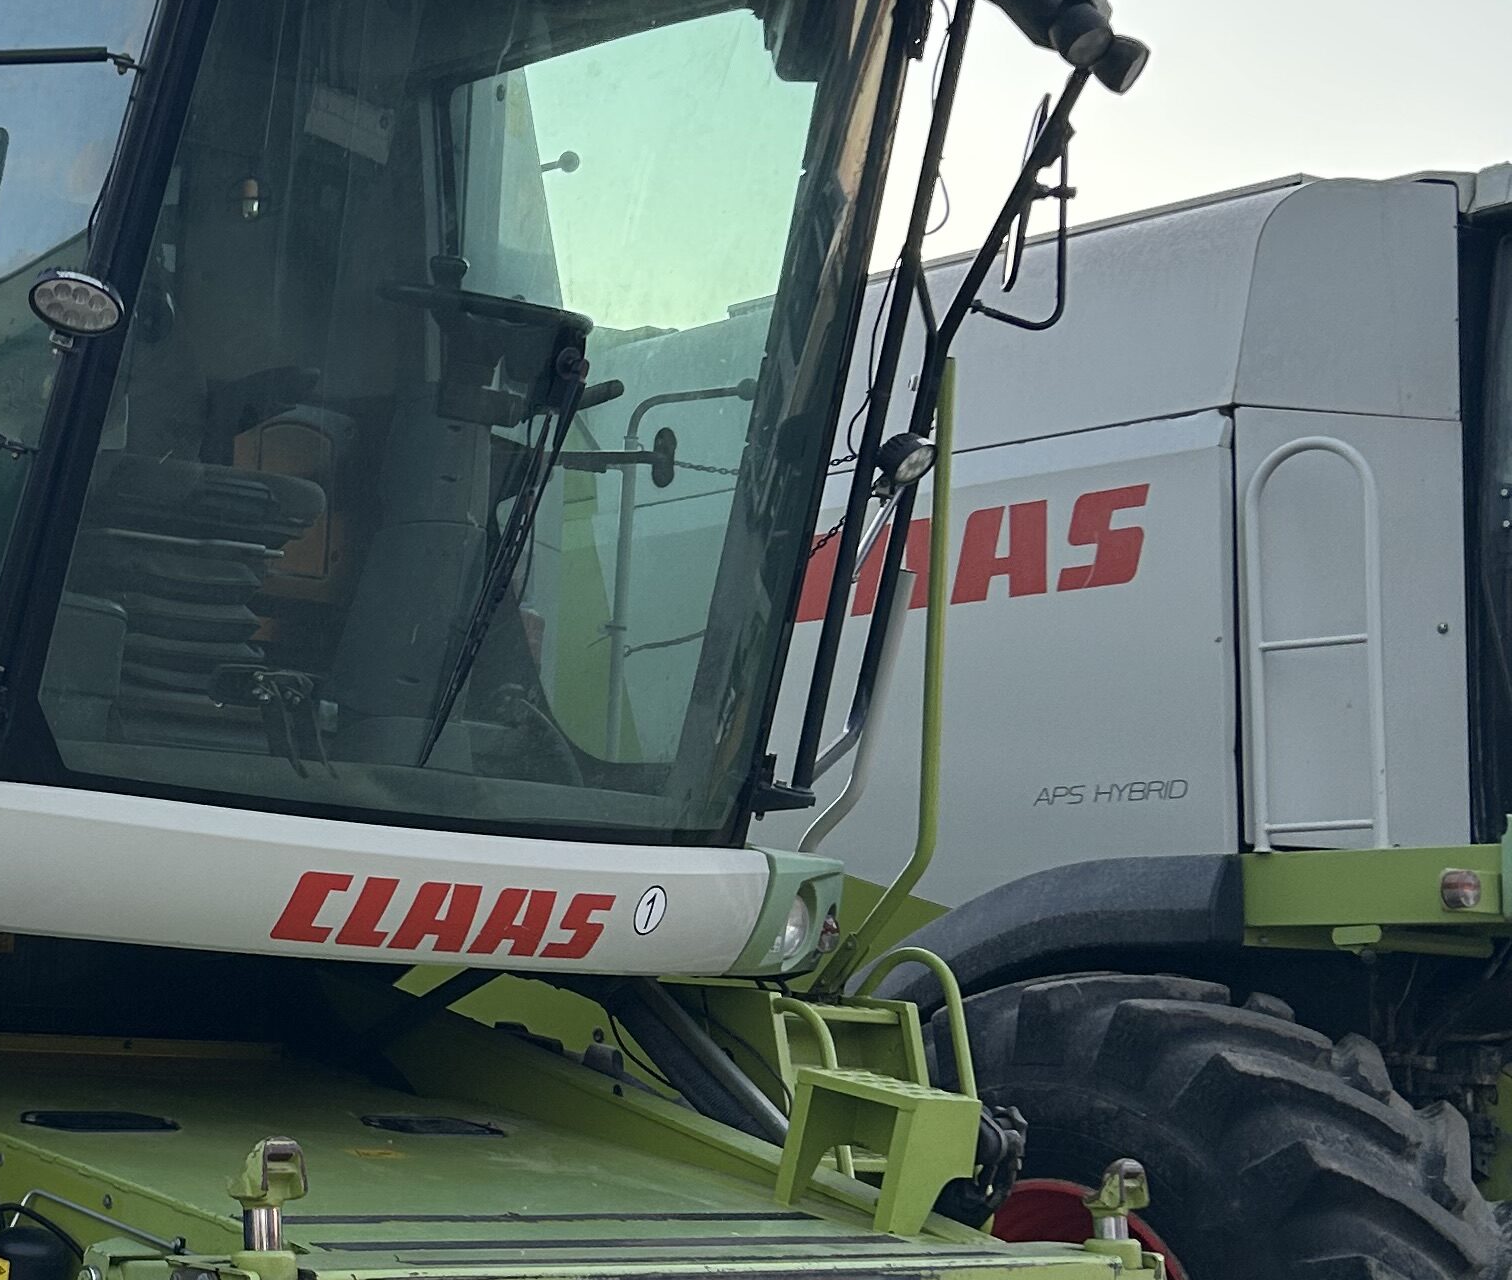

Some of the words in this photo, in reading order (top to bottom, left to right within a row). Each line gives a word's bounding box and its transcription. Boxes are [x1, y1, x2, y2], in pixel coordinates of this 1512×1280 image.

[1033, 785, 1086, 807] APS
[1092, 778, 1189, 803] HYBRID
[270, 871, 617, 960] CLAAS
